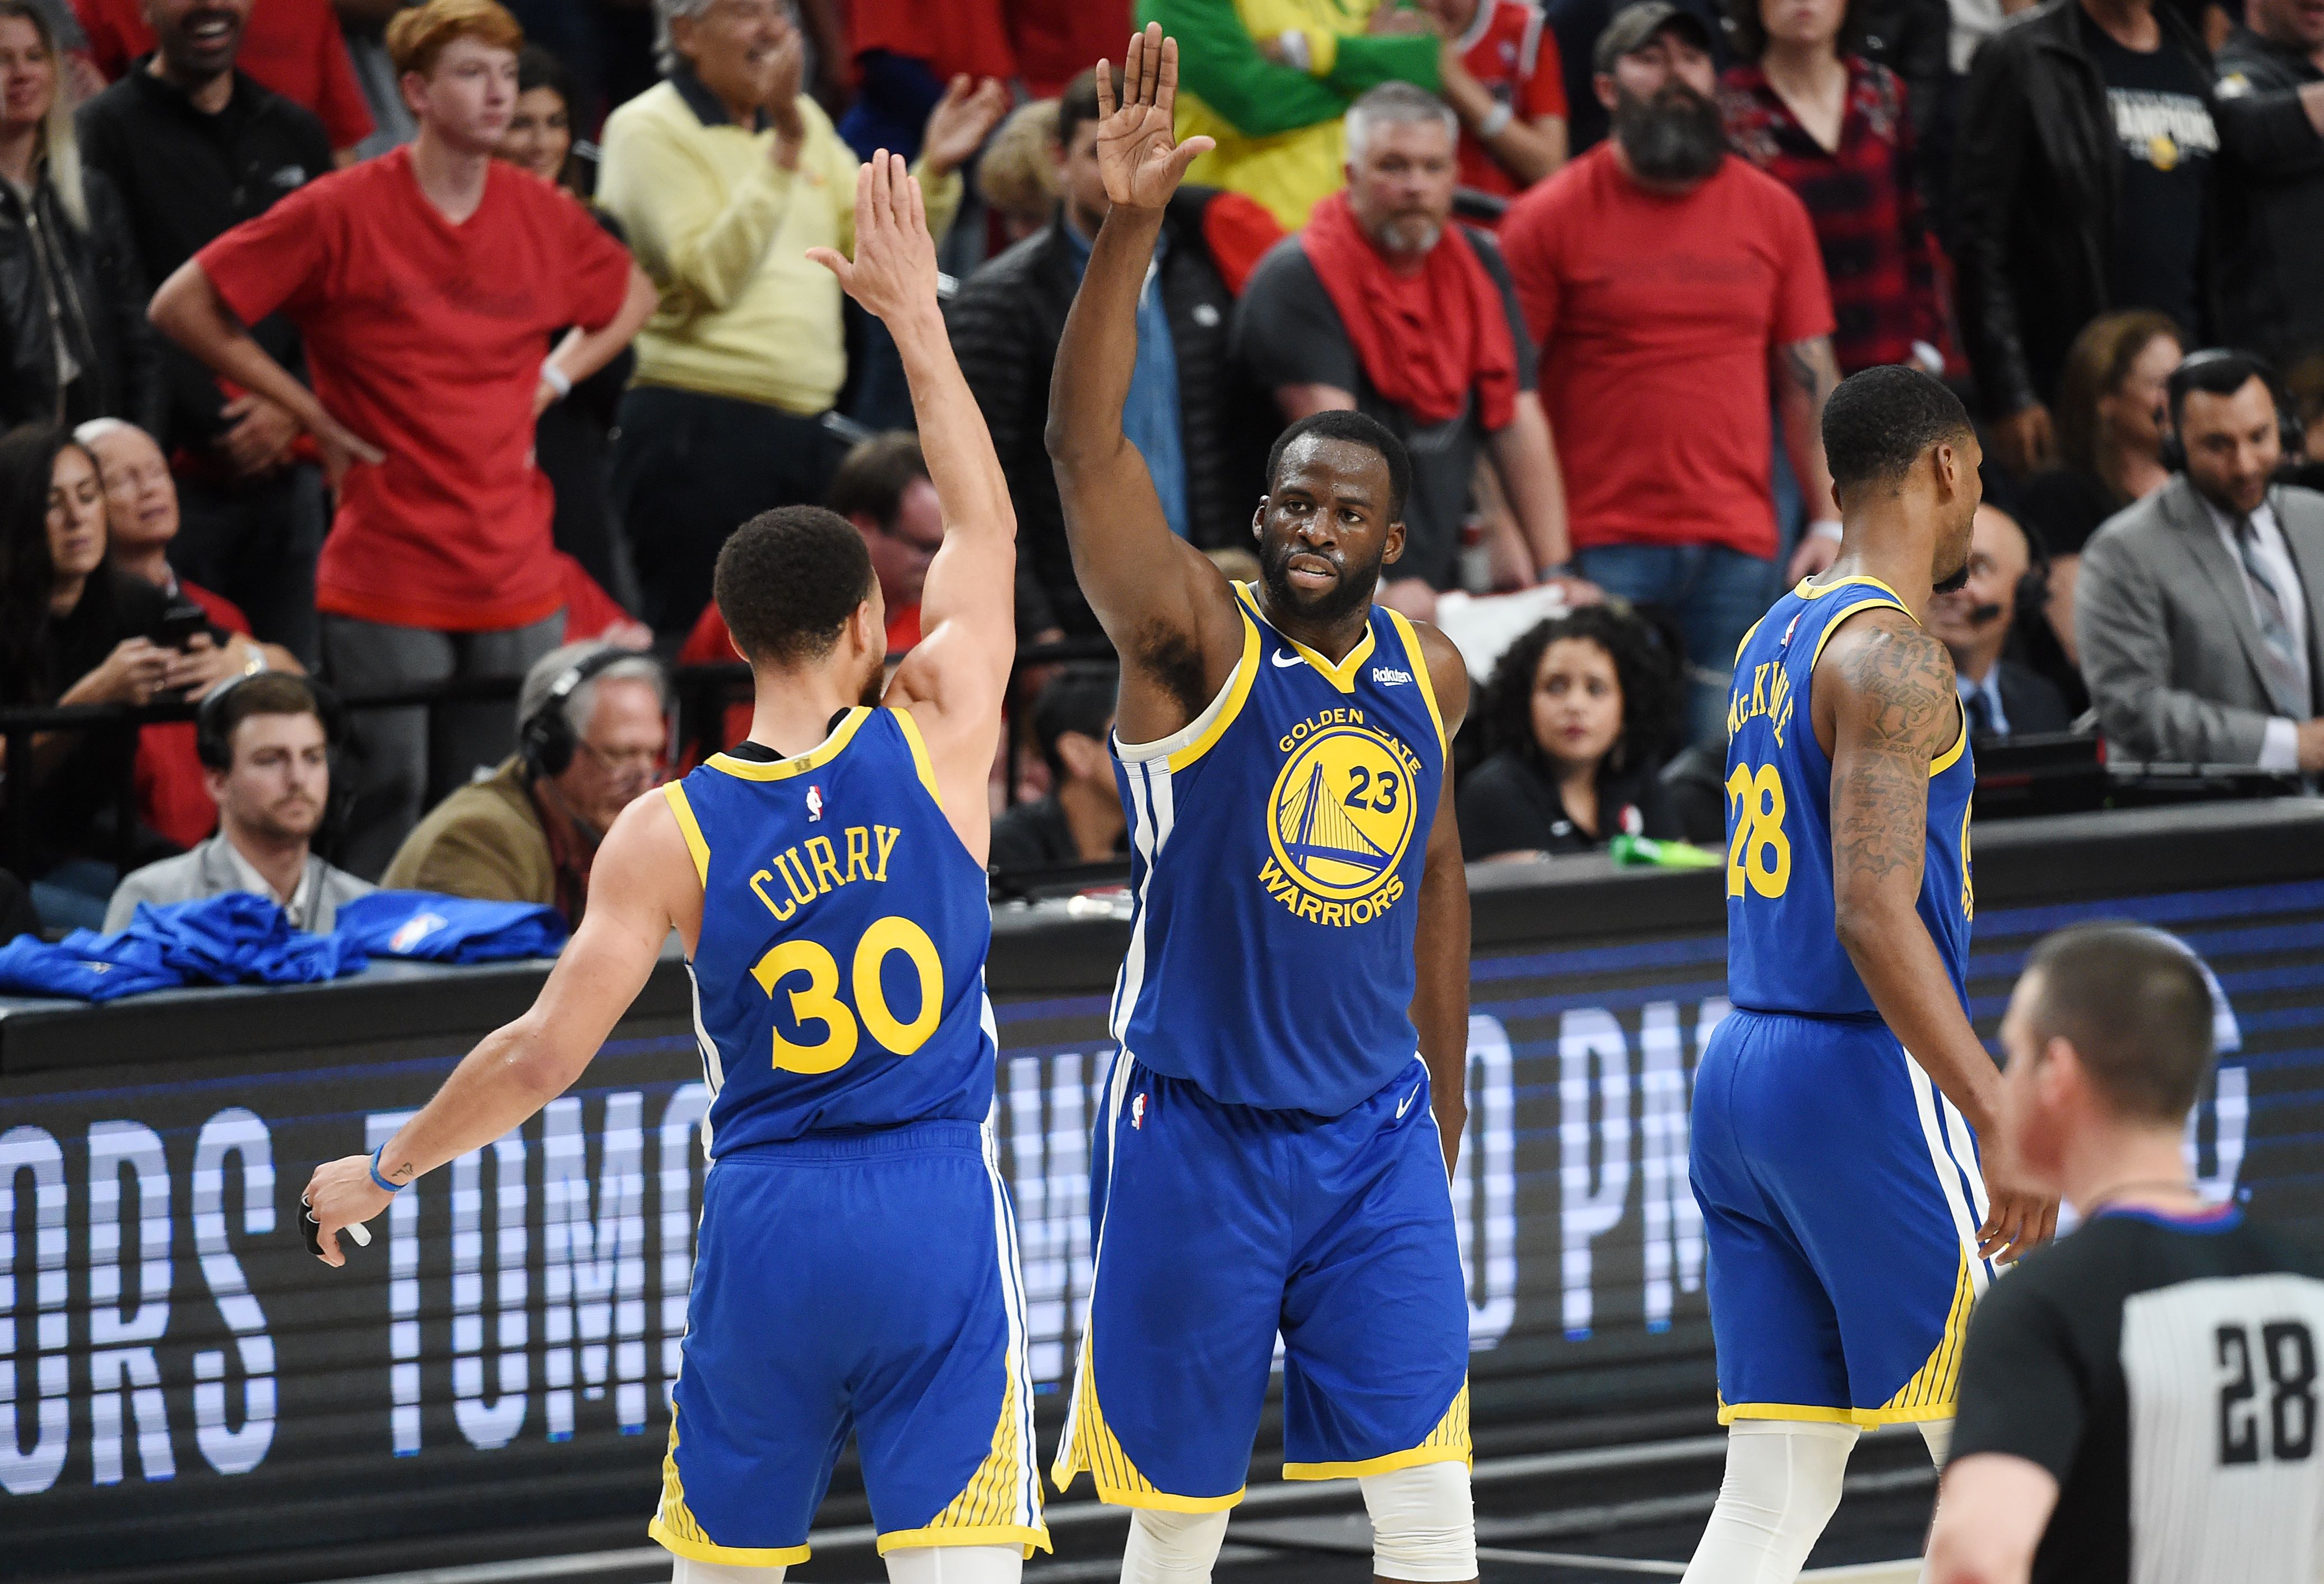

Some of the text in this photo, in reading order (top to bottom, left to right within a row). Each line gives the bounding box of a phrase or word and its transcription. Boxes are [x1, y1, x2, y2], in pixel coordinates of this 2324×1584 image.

[1372, 666, 1413, 684] Rakuten
[1279, 708, 1422, 776] GOLDEN ATE
[1345, 766, 1399, 814] 23
[749, 825, 901, 921] CURRY
[1725, 762, 1791, 902] 28
[1258, 856, 1405, 927] WARRIORS
[749, 916, 944, 1074] 30
[2216, 1322, 2318, 1466] 28
